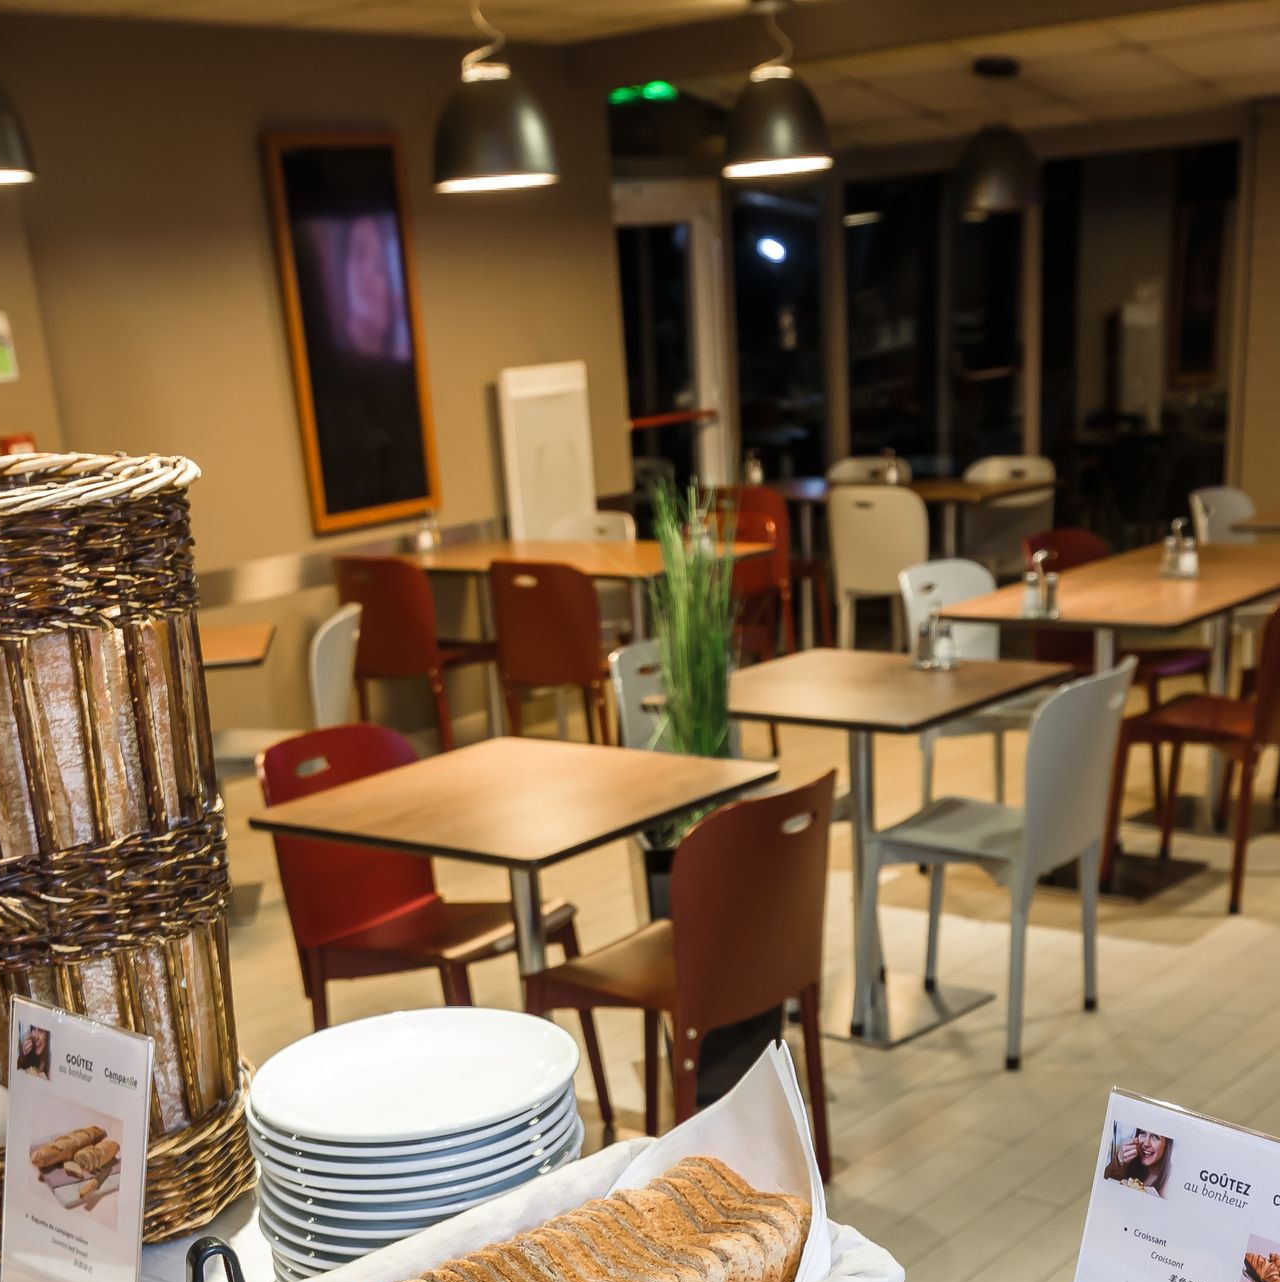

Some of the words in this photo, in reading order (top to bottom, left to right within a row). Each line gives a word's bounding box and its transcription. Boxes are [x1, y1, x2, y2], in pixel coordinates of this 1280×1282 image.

[1200, 1170, 1251, 1197] GOÛTEZ
[1184, 1182, 1199, 1193] au
[1202, 1183, 1248, 1209] bonheur
[1133, 1228, 1167, 1247] Croissant
[1150, 1251, 1184, 1270] Croissant
